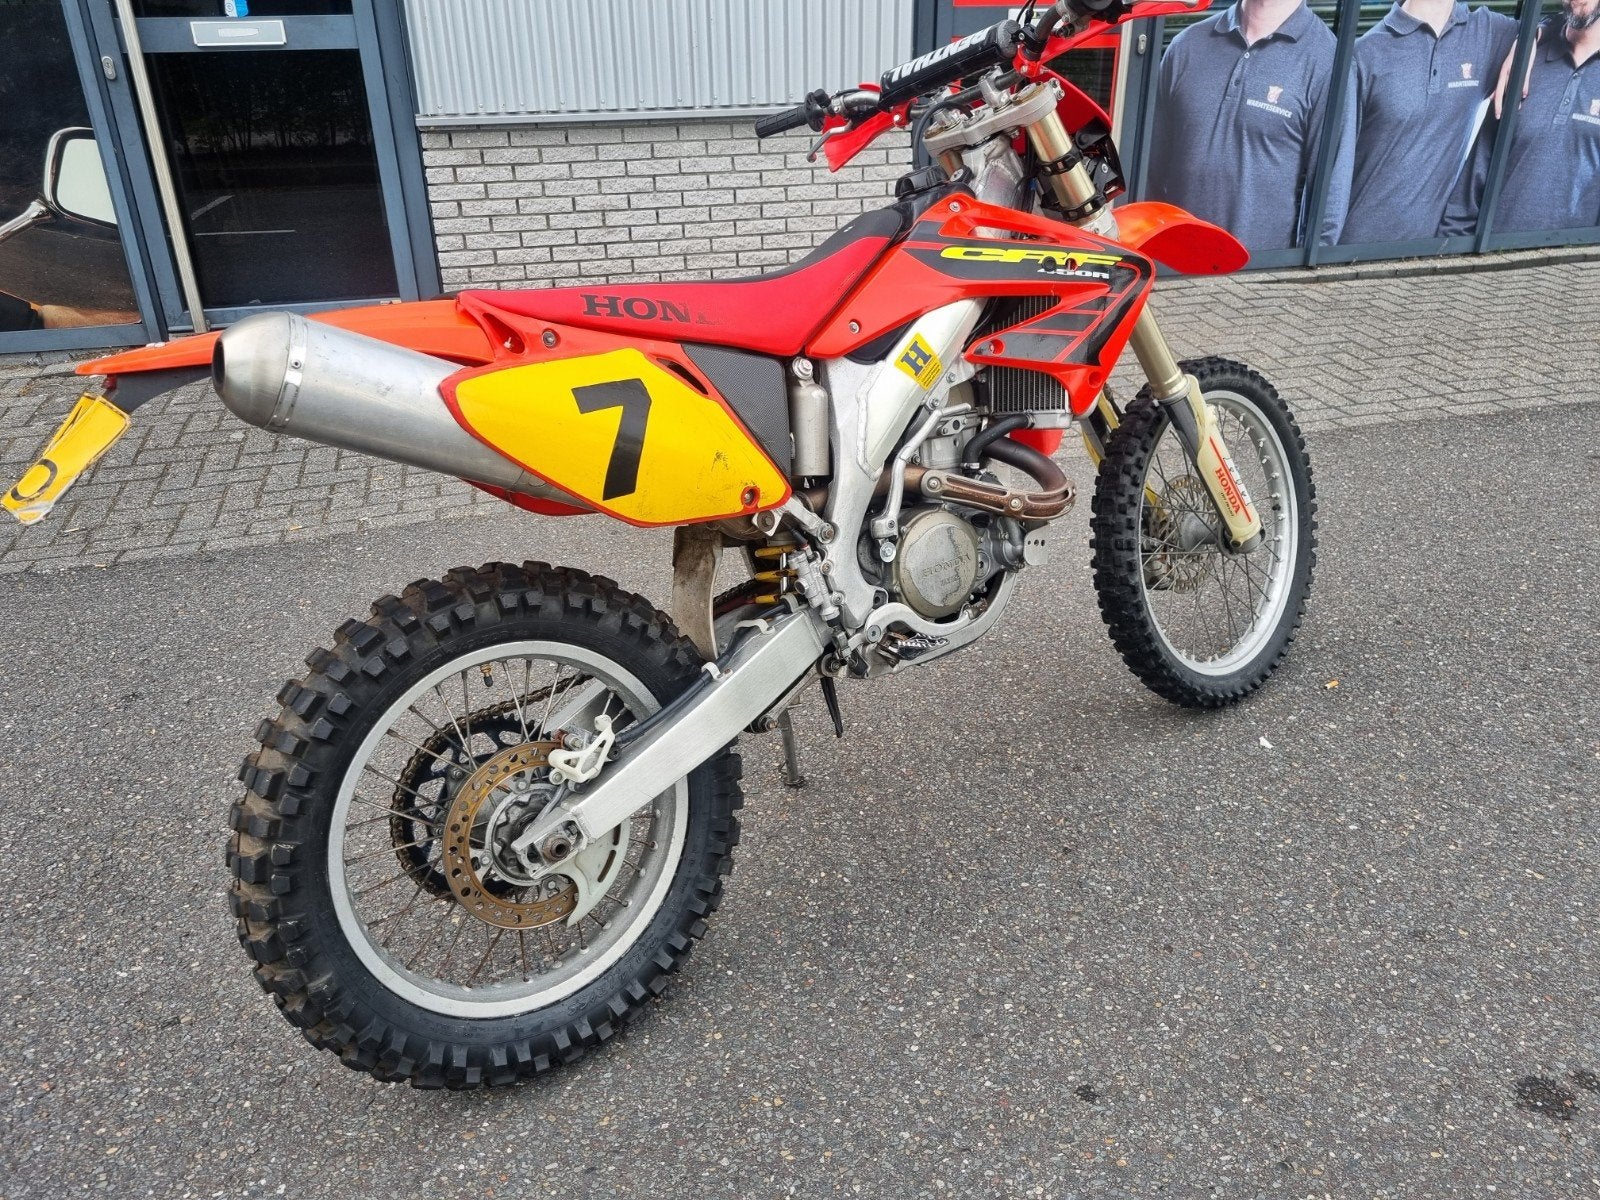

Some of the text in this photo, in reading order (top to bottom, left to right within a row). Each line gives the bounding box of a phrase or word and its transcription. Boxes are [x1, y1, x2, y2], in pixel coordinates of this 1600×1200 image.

[1246, 99, 1292, 118] WARMTESERVICE
[940, 246, 1122, 265] CRF
[900, 341, 932, 377] H
[571, 378, 653, 501] 7
[1215, 467, 1241, 514] HONDA
